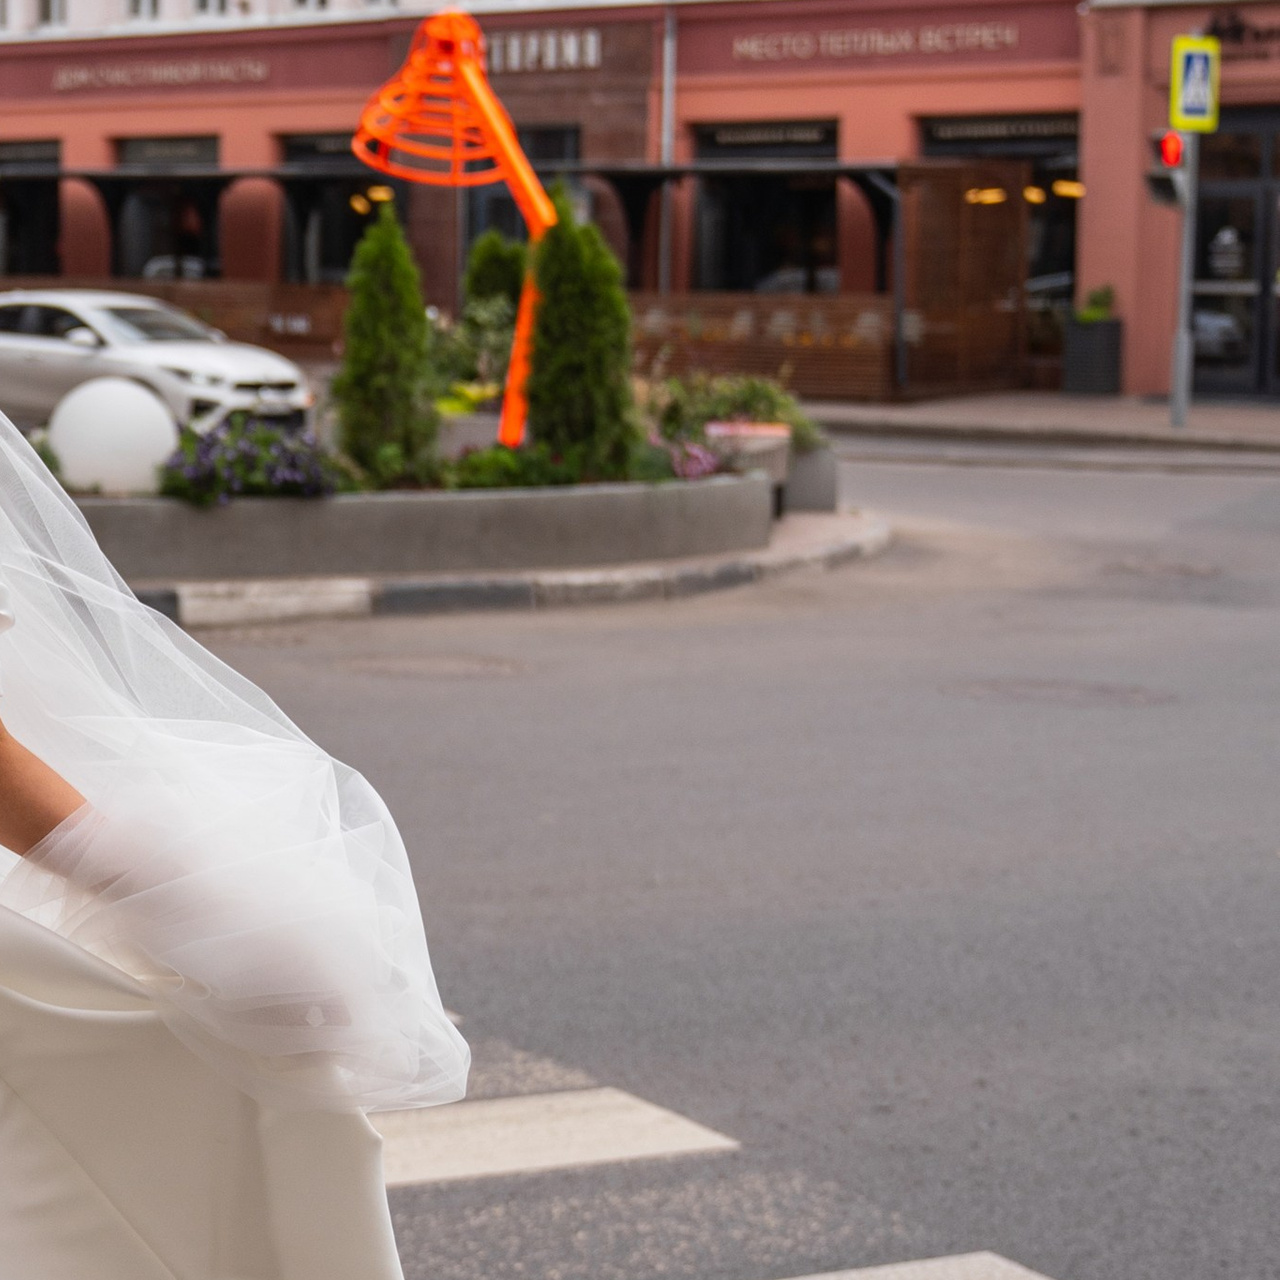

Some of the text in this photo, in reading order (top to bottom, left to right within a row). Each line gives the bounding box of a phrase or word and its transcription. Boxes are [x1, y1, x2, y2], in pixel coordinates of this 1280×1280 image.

[733, 23, 1018, 60] МЕСТО ТЕПЛЫХ ВСТРЕЧ
